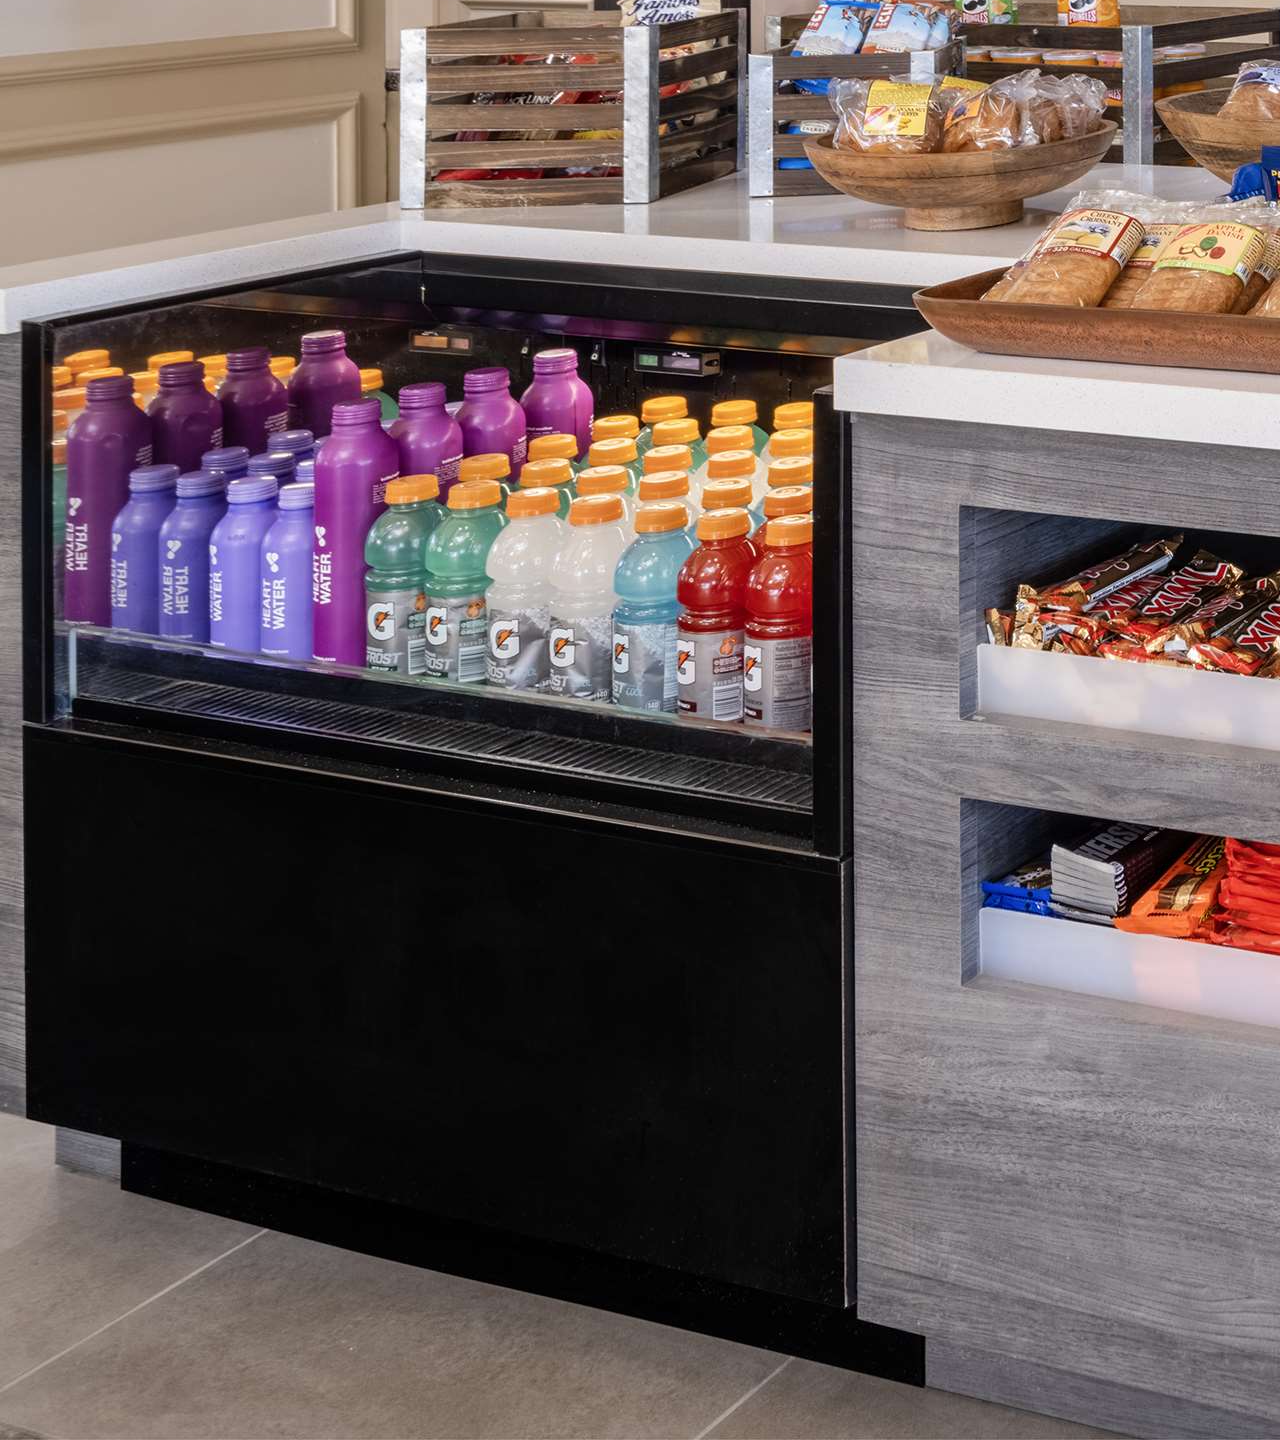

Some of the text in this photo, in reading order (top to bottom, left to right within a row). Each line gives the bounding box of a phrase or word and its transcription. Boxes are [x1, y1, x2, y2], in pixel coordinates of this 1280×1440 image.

[641, 9, 690, 24] Amos
[963, 12, 989, 24] PRINGLES
[1068, 10, 1097, 24] PRINGLES
[1079, 215, 1123, 228] CROISSANT
[1089, 210, 1120, 222] CHEESE
[1206, 228, 1245, 241] DANISH
[1214, 223, 1244, 235] APPLE
[1052, 245, 1102, 257] 320 CALORIES
[211, 570, 223, 623] WATER
[312, 553, 321, 603] HEART
[319, 551, 333, 605] WATER
[1142, 561, 1231, 616] TWIX
[261, 578, 271, 629] HEART
[273, 577, 285, 630] WATER
[367, 602, 396, 641] G
[425, 606, 448, 646] G
[489, 619, 520, 659] G
[550, 628, 576, 668] G
